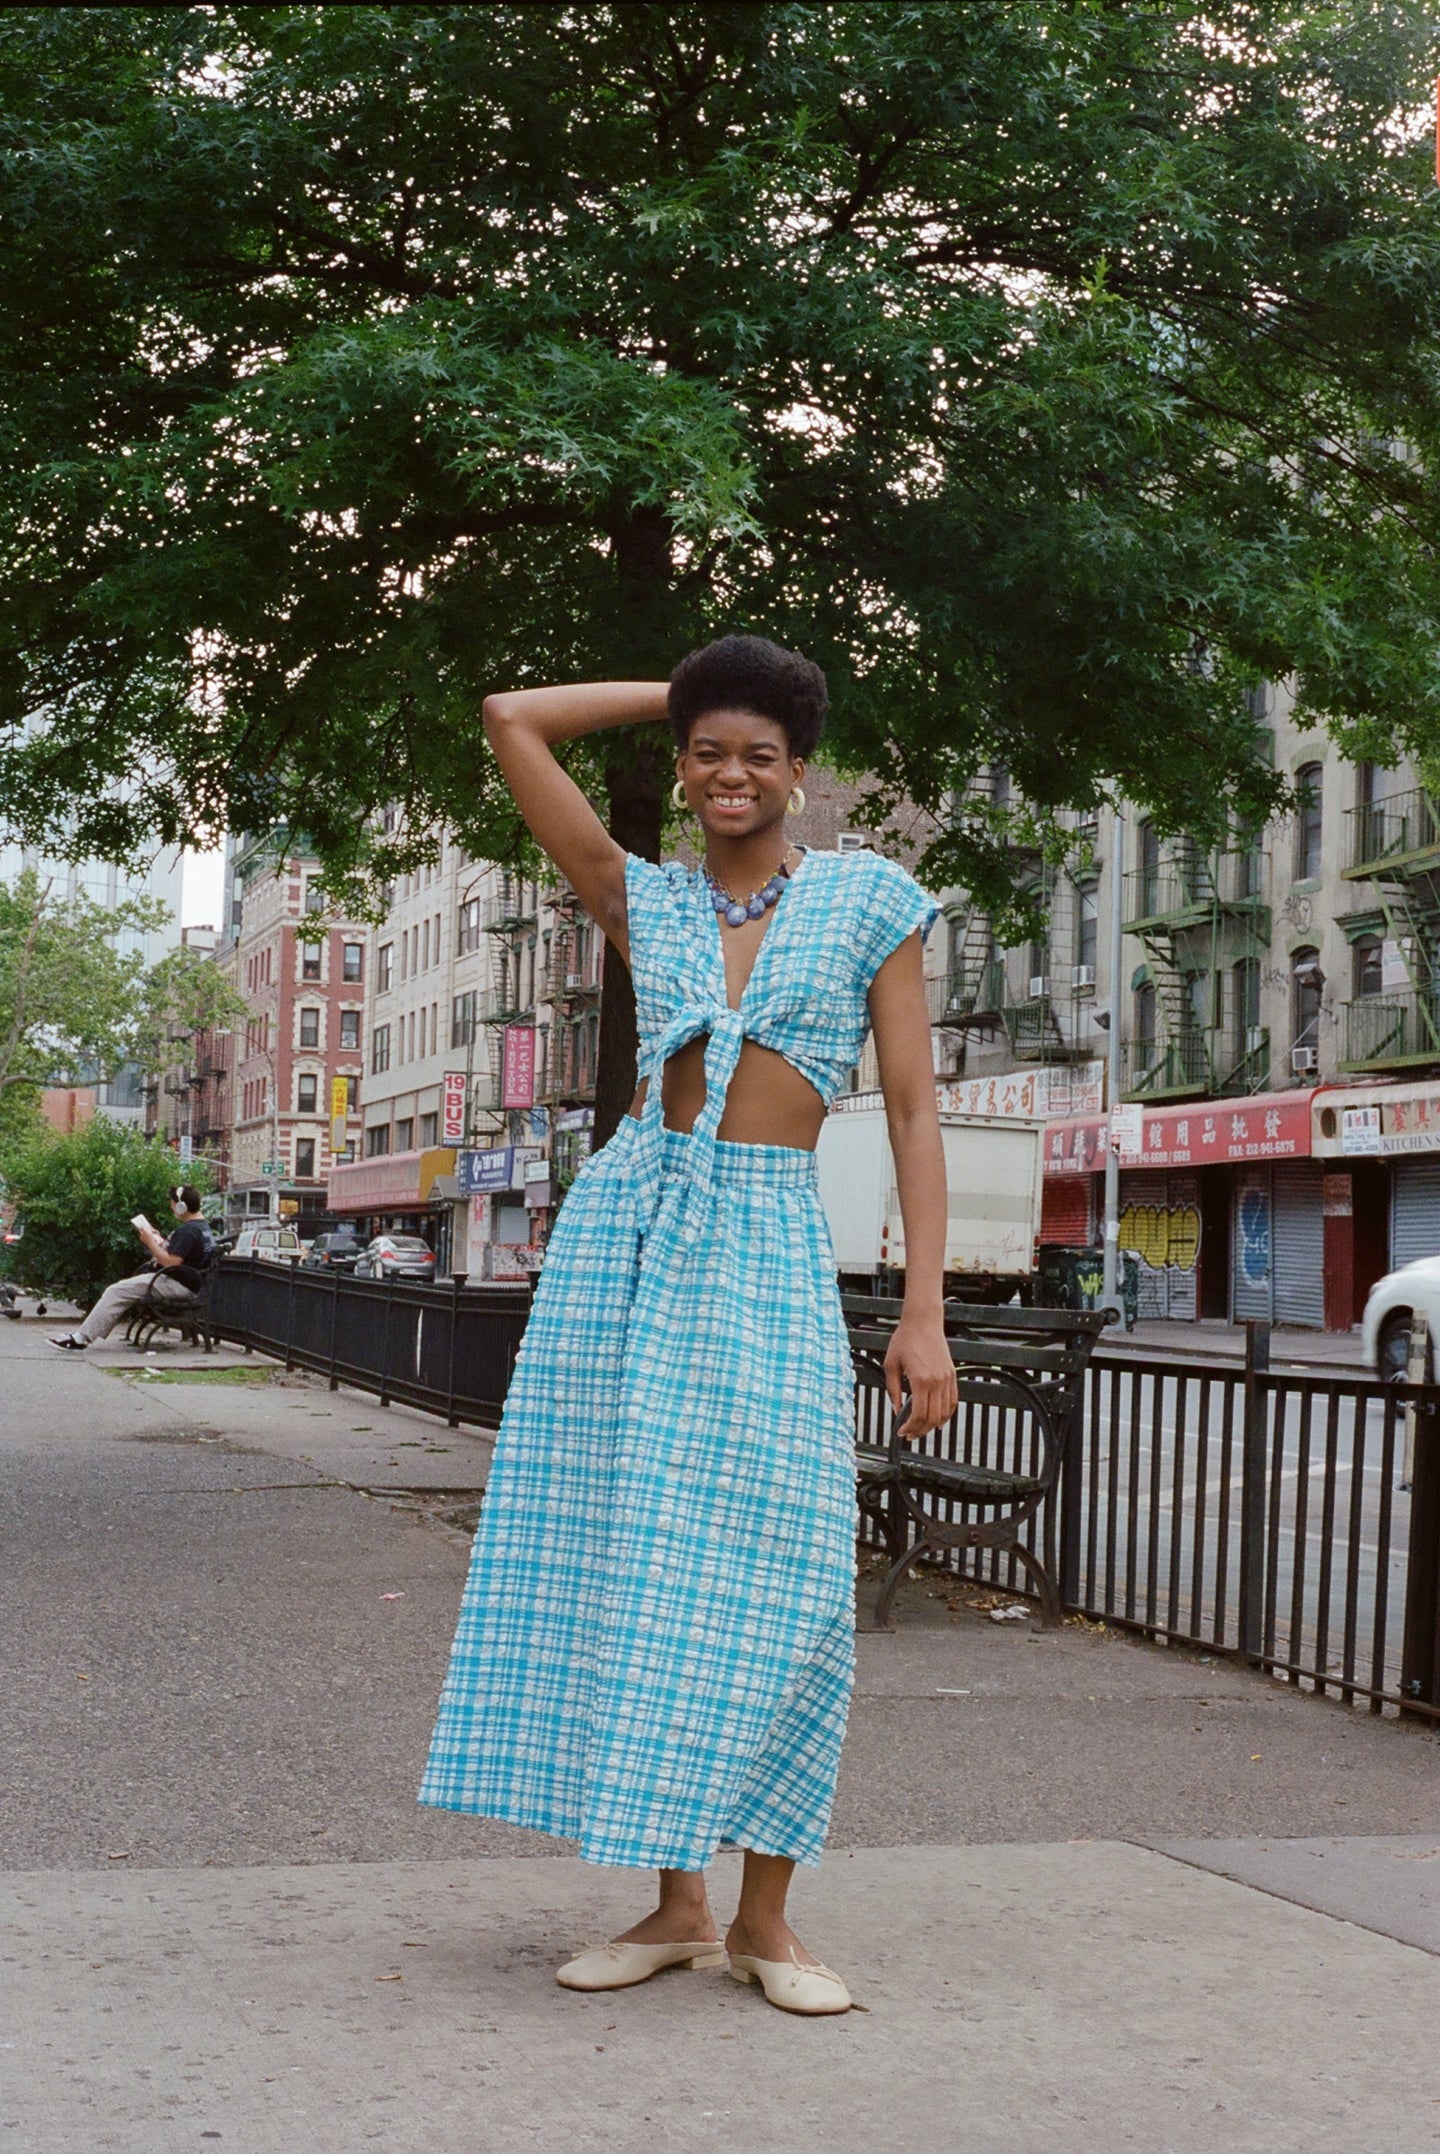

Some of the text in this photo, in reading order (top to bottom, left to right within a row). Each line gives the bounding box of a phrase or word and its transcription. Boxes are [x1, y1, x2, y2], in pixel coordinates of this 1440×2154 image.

[517, 1030, 530, 1095] 第一巴士公司
[507, 1070, 516, 1094] TOUR
[445, 1075, 465, 1136] 19 BUS
[1391, 1100, 1440, 1132] 餐具
[1228, 1144, 1245, 1158] FAX:
[1383, 1135, 1433, 1152] KITCHEN
